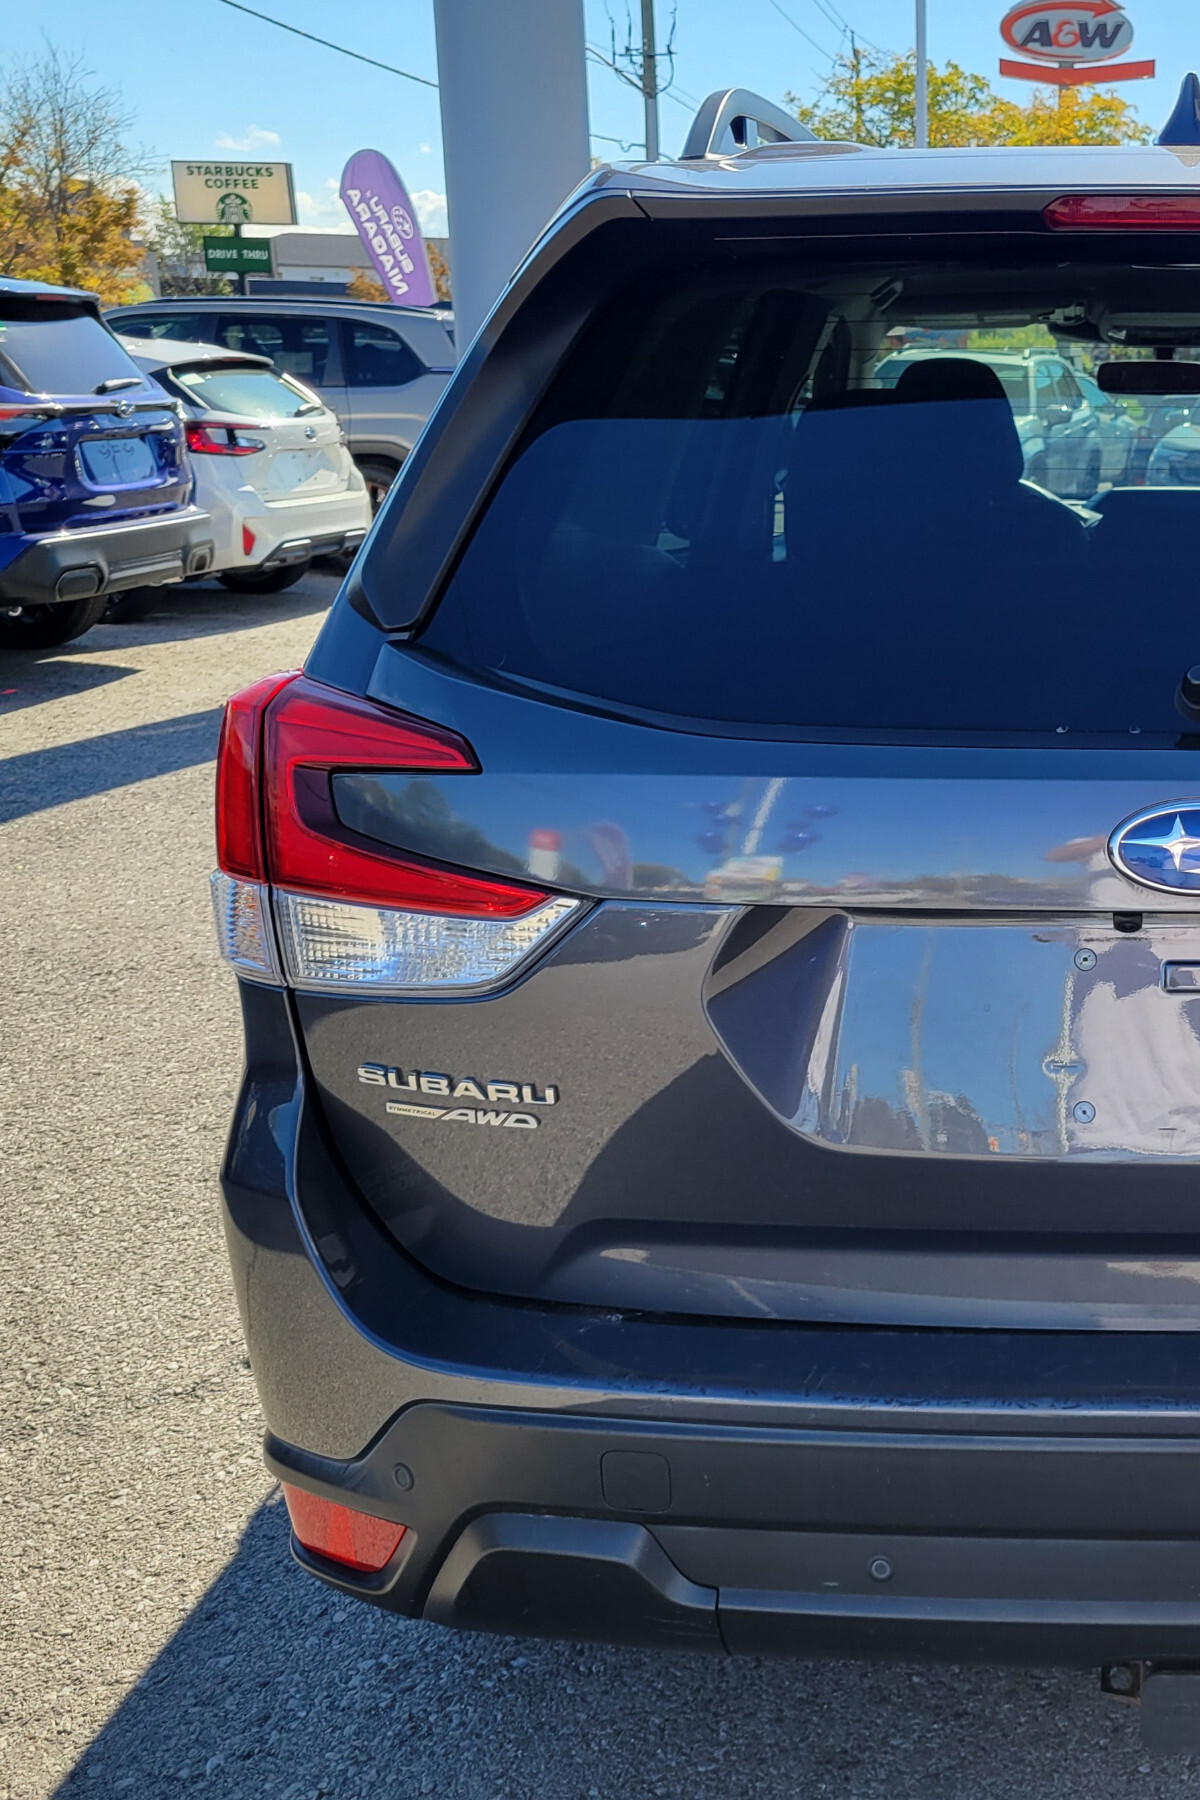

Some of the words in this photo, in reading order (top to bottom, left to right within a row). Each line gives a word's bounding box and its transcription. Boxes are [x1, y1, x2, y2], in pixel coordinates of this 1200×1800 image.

[1019, 18, 1126, 49] A&W
[186, 165, 274, 177] STARBUCKS
[204, 178, 260, 189] COFFEE
[207, 248, 239, 259] DRIVE
[241, 249, 269, 260] THRU
[357, 1062, 558, 1105] SUBARU
[387, 1104, 437, 1117] SYMMETRICAL
[441, 1108, 539, 1129] AWD
